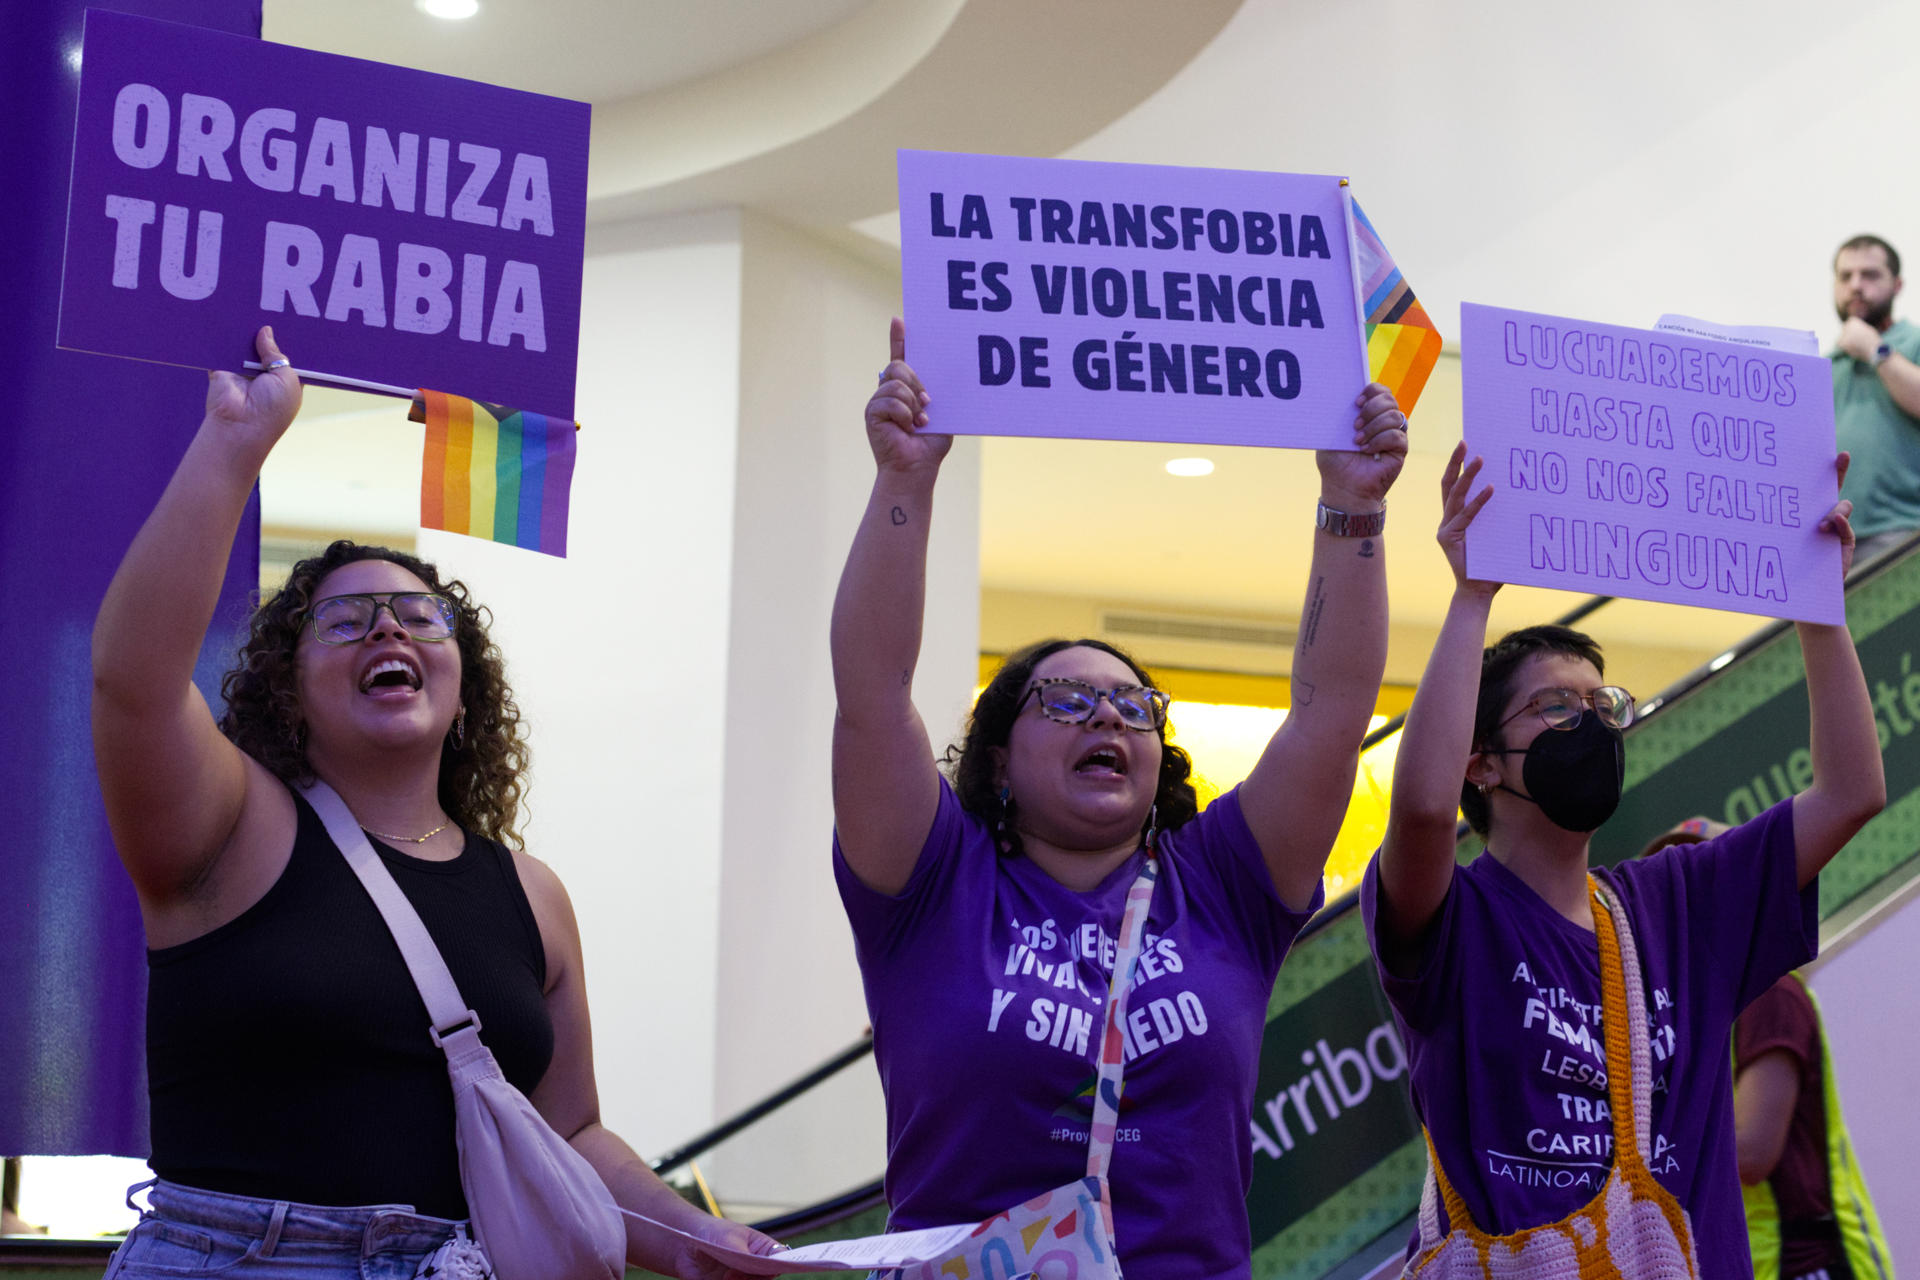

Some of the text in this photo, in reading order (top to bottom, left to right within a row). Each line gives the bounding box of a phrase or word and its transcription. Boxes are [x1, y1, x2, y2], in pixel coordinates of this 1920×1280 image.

[112, 83, 554, 236] ORGANIZA
[930, 192, 1331, 260] LA TRANSFOBIA
[105, 194, 547, 352] TU RABIA
[947, 260, 1325, 329] ES VIOLENCIA
[977, 331, 1302, 401] DE GÉNERO
[1504, 321, 1797, 406] LUCHAREMOS
[1531, 388, 1777, 467] HASTA QUE
[1509, 447, 1801, 528] NO NOS FALTE
[1530, 513, 1788, 602] NINGUNA
[1011, 917, 1057, 950] OS
[987, 988, 1017, 1032] Y
[1025, 998, 1093, 1057] SIN
